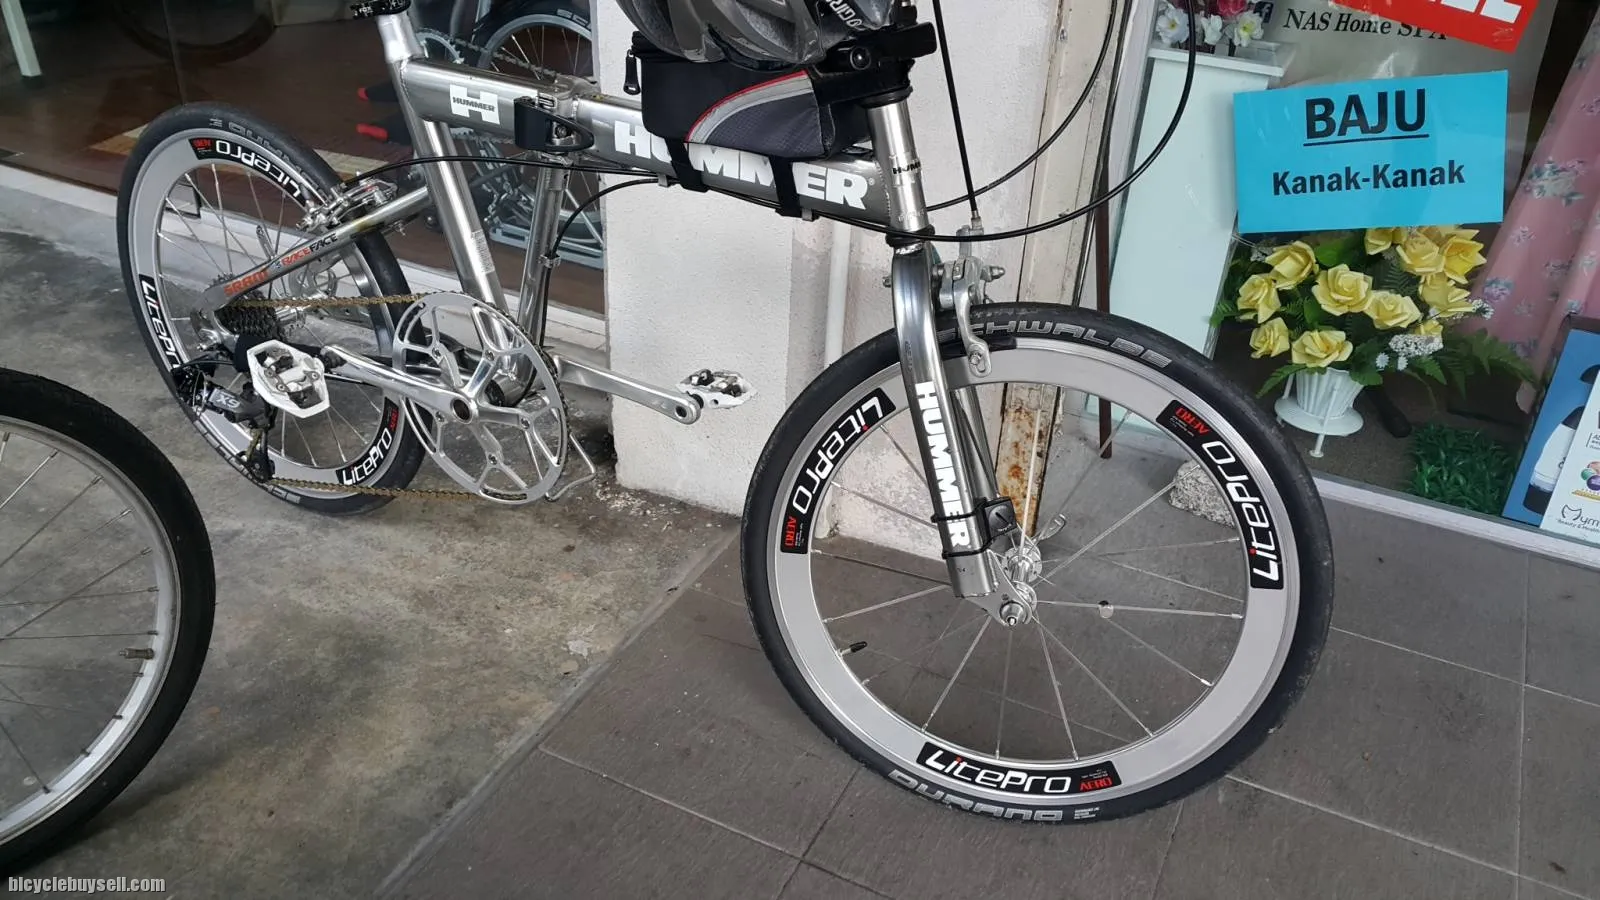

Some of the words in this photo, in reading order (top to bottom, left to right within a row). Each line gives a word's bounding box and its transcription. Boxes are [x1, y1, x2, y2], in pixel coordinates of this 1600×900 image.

[825, 0, 856, 20] GIR
[1283, 8, 1332, 31] NAS
[1334, 13, 1391, 34] Home
[452, 96, 496, 112] HUMMER
[1304, 88, 1427, 139] BAJU
[1273, 159, 1465, 196] Kanak-Kanak
[142, 280, 182, 368] LitePr
[915, 381, 970, 548] HUMMER
